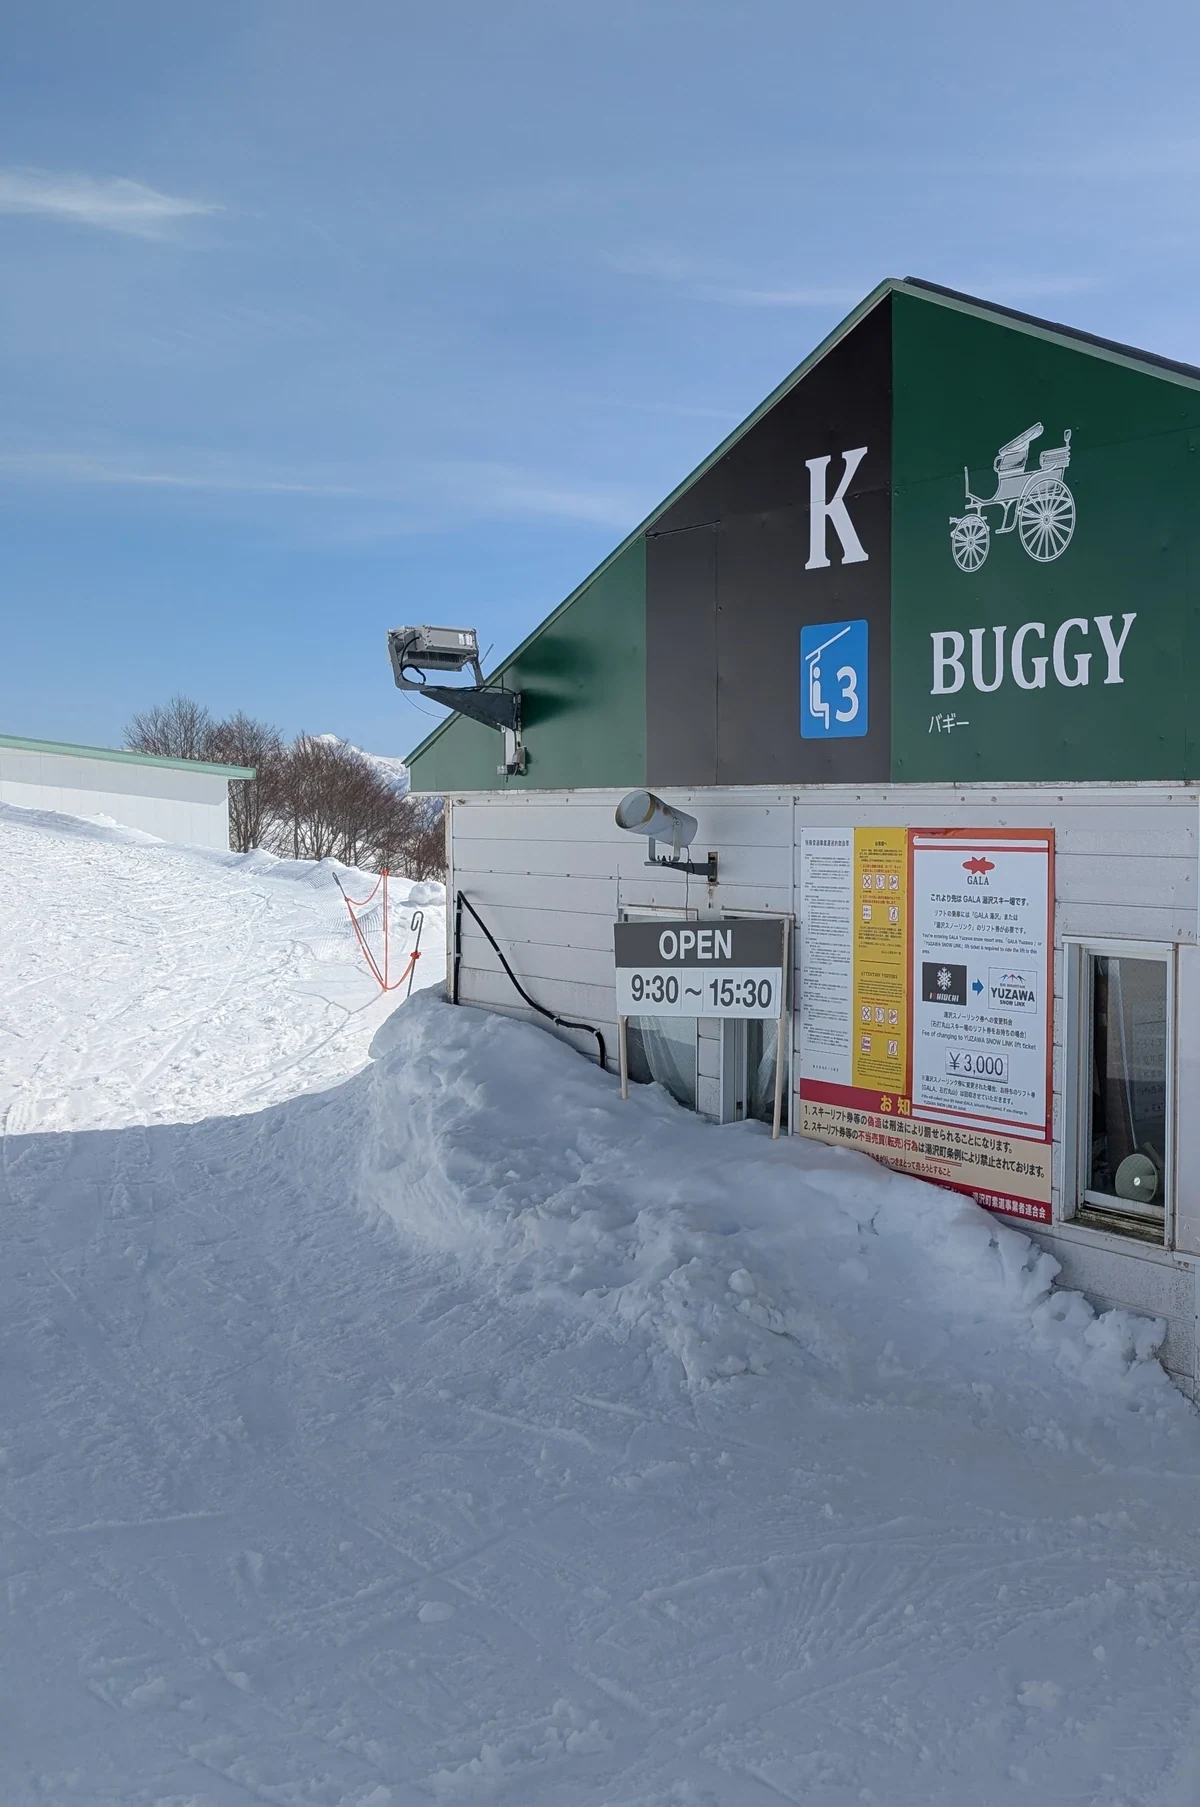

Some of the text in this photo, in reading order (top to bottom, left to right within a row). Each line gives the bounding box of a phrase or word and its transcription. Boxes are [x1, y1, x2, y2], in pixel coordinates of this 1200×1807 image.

[805, 446, 869, 570] K
[930, 612, 1137, 695] BUGGY
[835, 665, 859, 722] 3
[928, 712, 970, 734] バギー
[967, 875, 990, 886] GALA
[930, 893, 962, 903] これより先は
[963, 896, 981, 904] GALA
[658, 929, 732, 960] OPEN
[990, 986, 1036, 1002] YUZAWA
[936, 1032, 957, 1041] changing
[963, 1035, 986, 1044] YUZAWA
[986, 1037, 1001, 1045] SNOW
[1002, 1039, 1014, 1047] LINK
